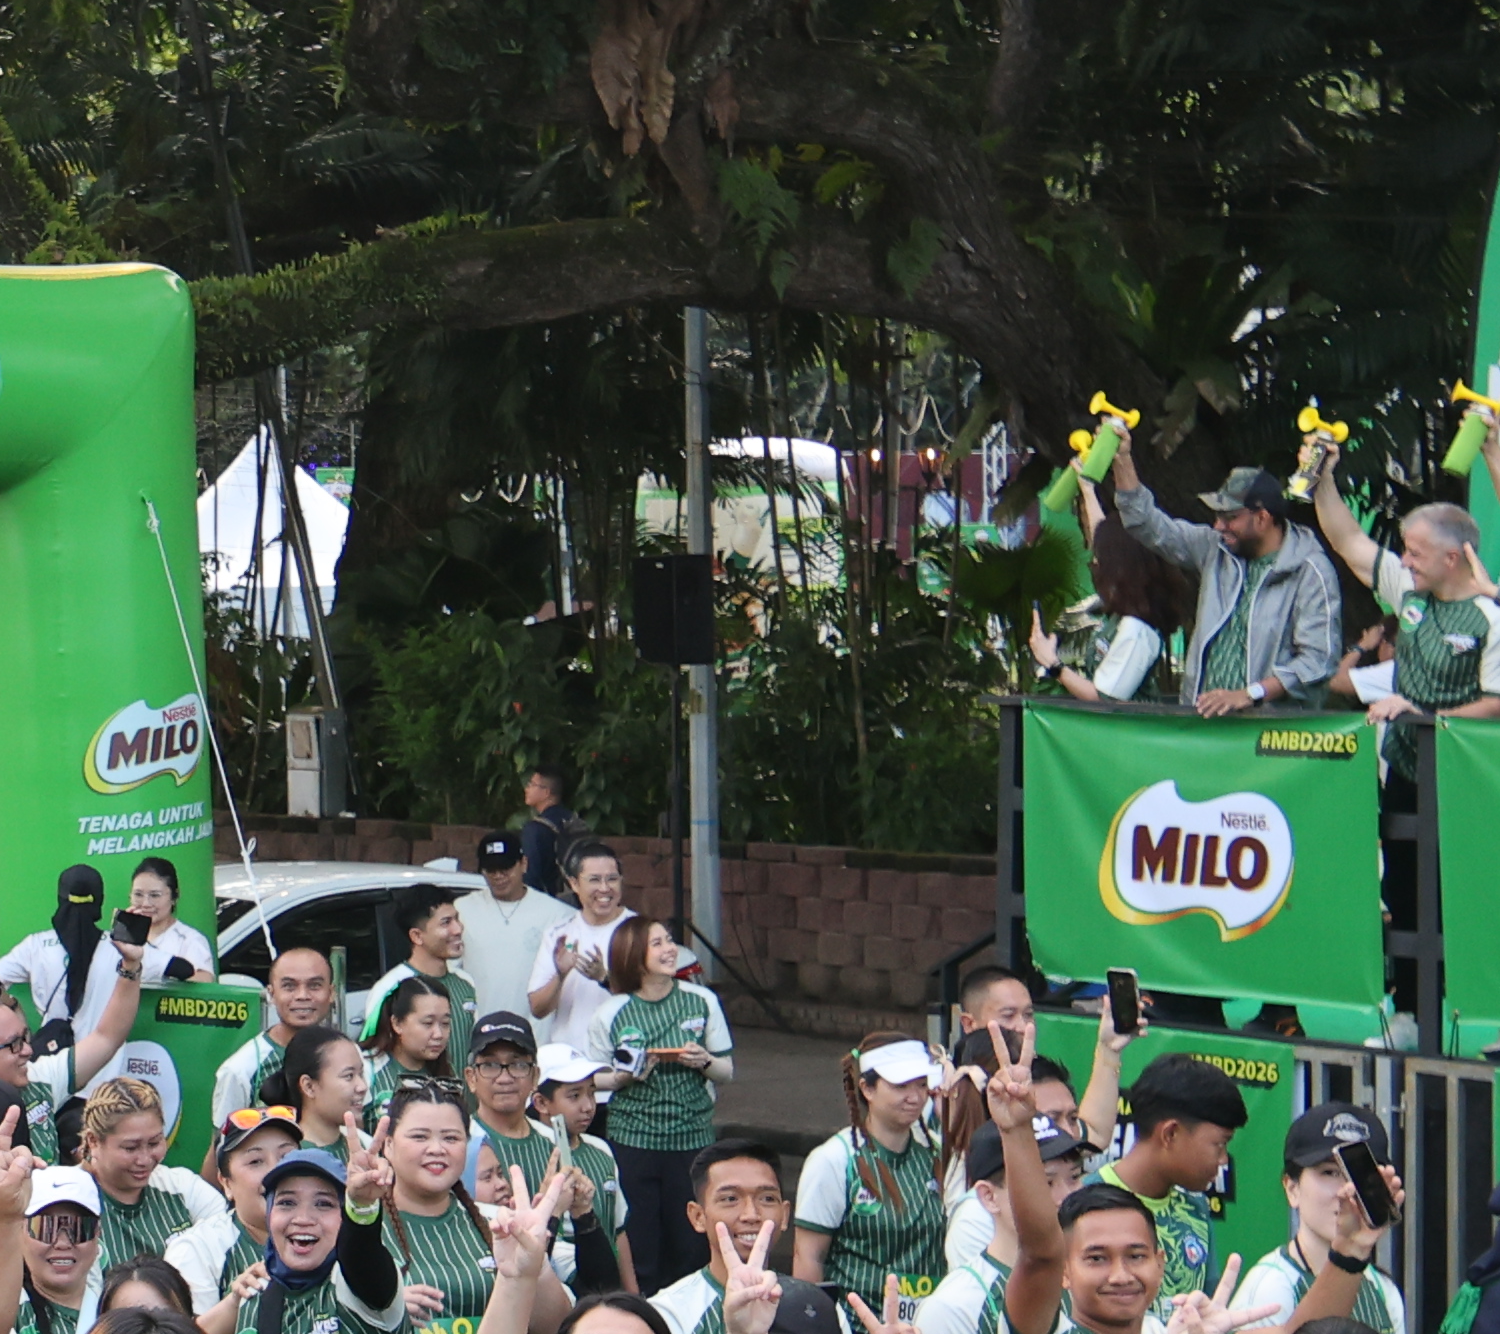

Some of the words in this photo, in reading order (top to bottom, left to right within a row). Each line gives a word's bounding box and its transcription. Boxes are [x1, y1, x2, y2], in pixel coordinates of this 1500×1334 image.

[106, 719, 199, 771] MILO
[1260, 729, 1359, 754] #MBD2026
[77, 811, 154, 834] TENAGA
[158, 801, 205, 825] UNTUK
[1220, 811, 1268, 832] Nestlé
[86, 827, 195, 856] MELANGKAH
[1131, 823, 1270, 892] MILO
[158, 997, 249, 1021] #MBD2026
[127, 1057, 160, 1076] estlé
[1192, 1053, 1279, 1084] BD2026
